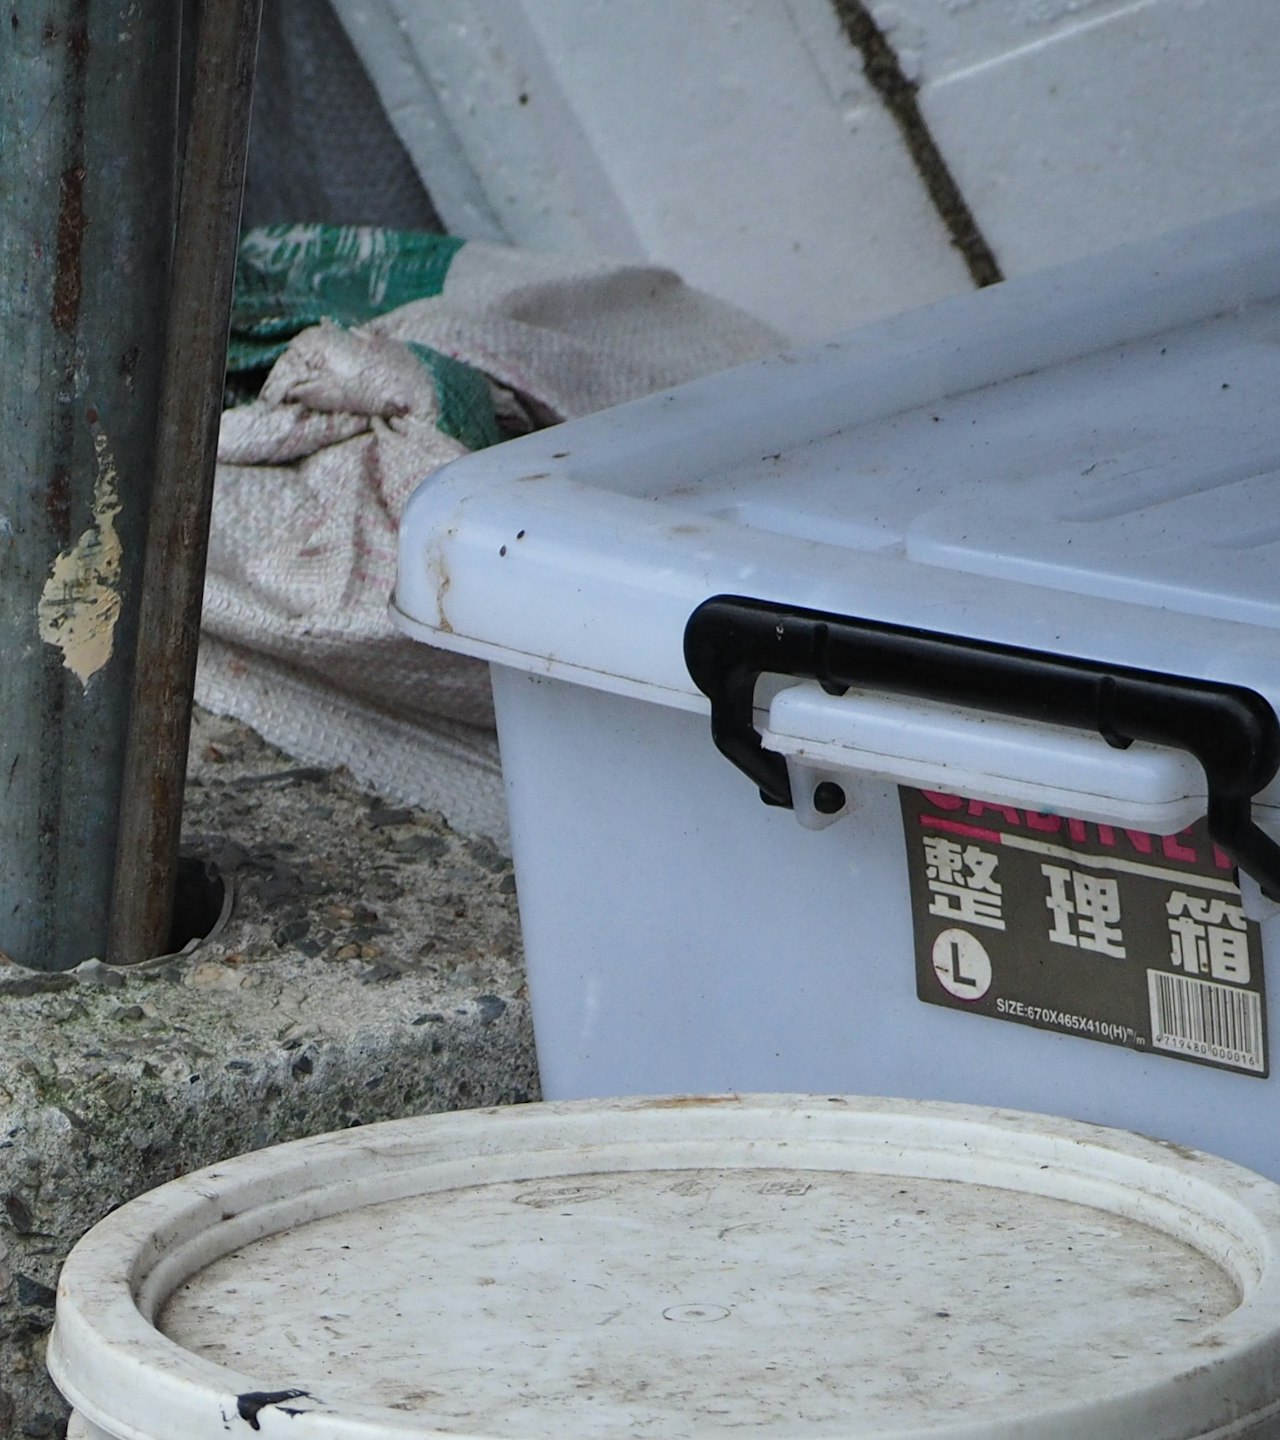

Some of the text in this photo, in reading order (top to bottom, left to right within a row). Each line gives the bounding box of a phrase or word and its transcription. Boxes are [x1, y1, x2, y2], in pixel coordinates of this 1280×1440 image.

[922, 836, 1251, 985] 整理箱
[948, 941, 977, 988] L
